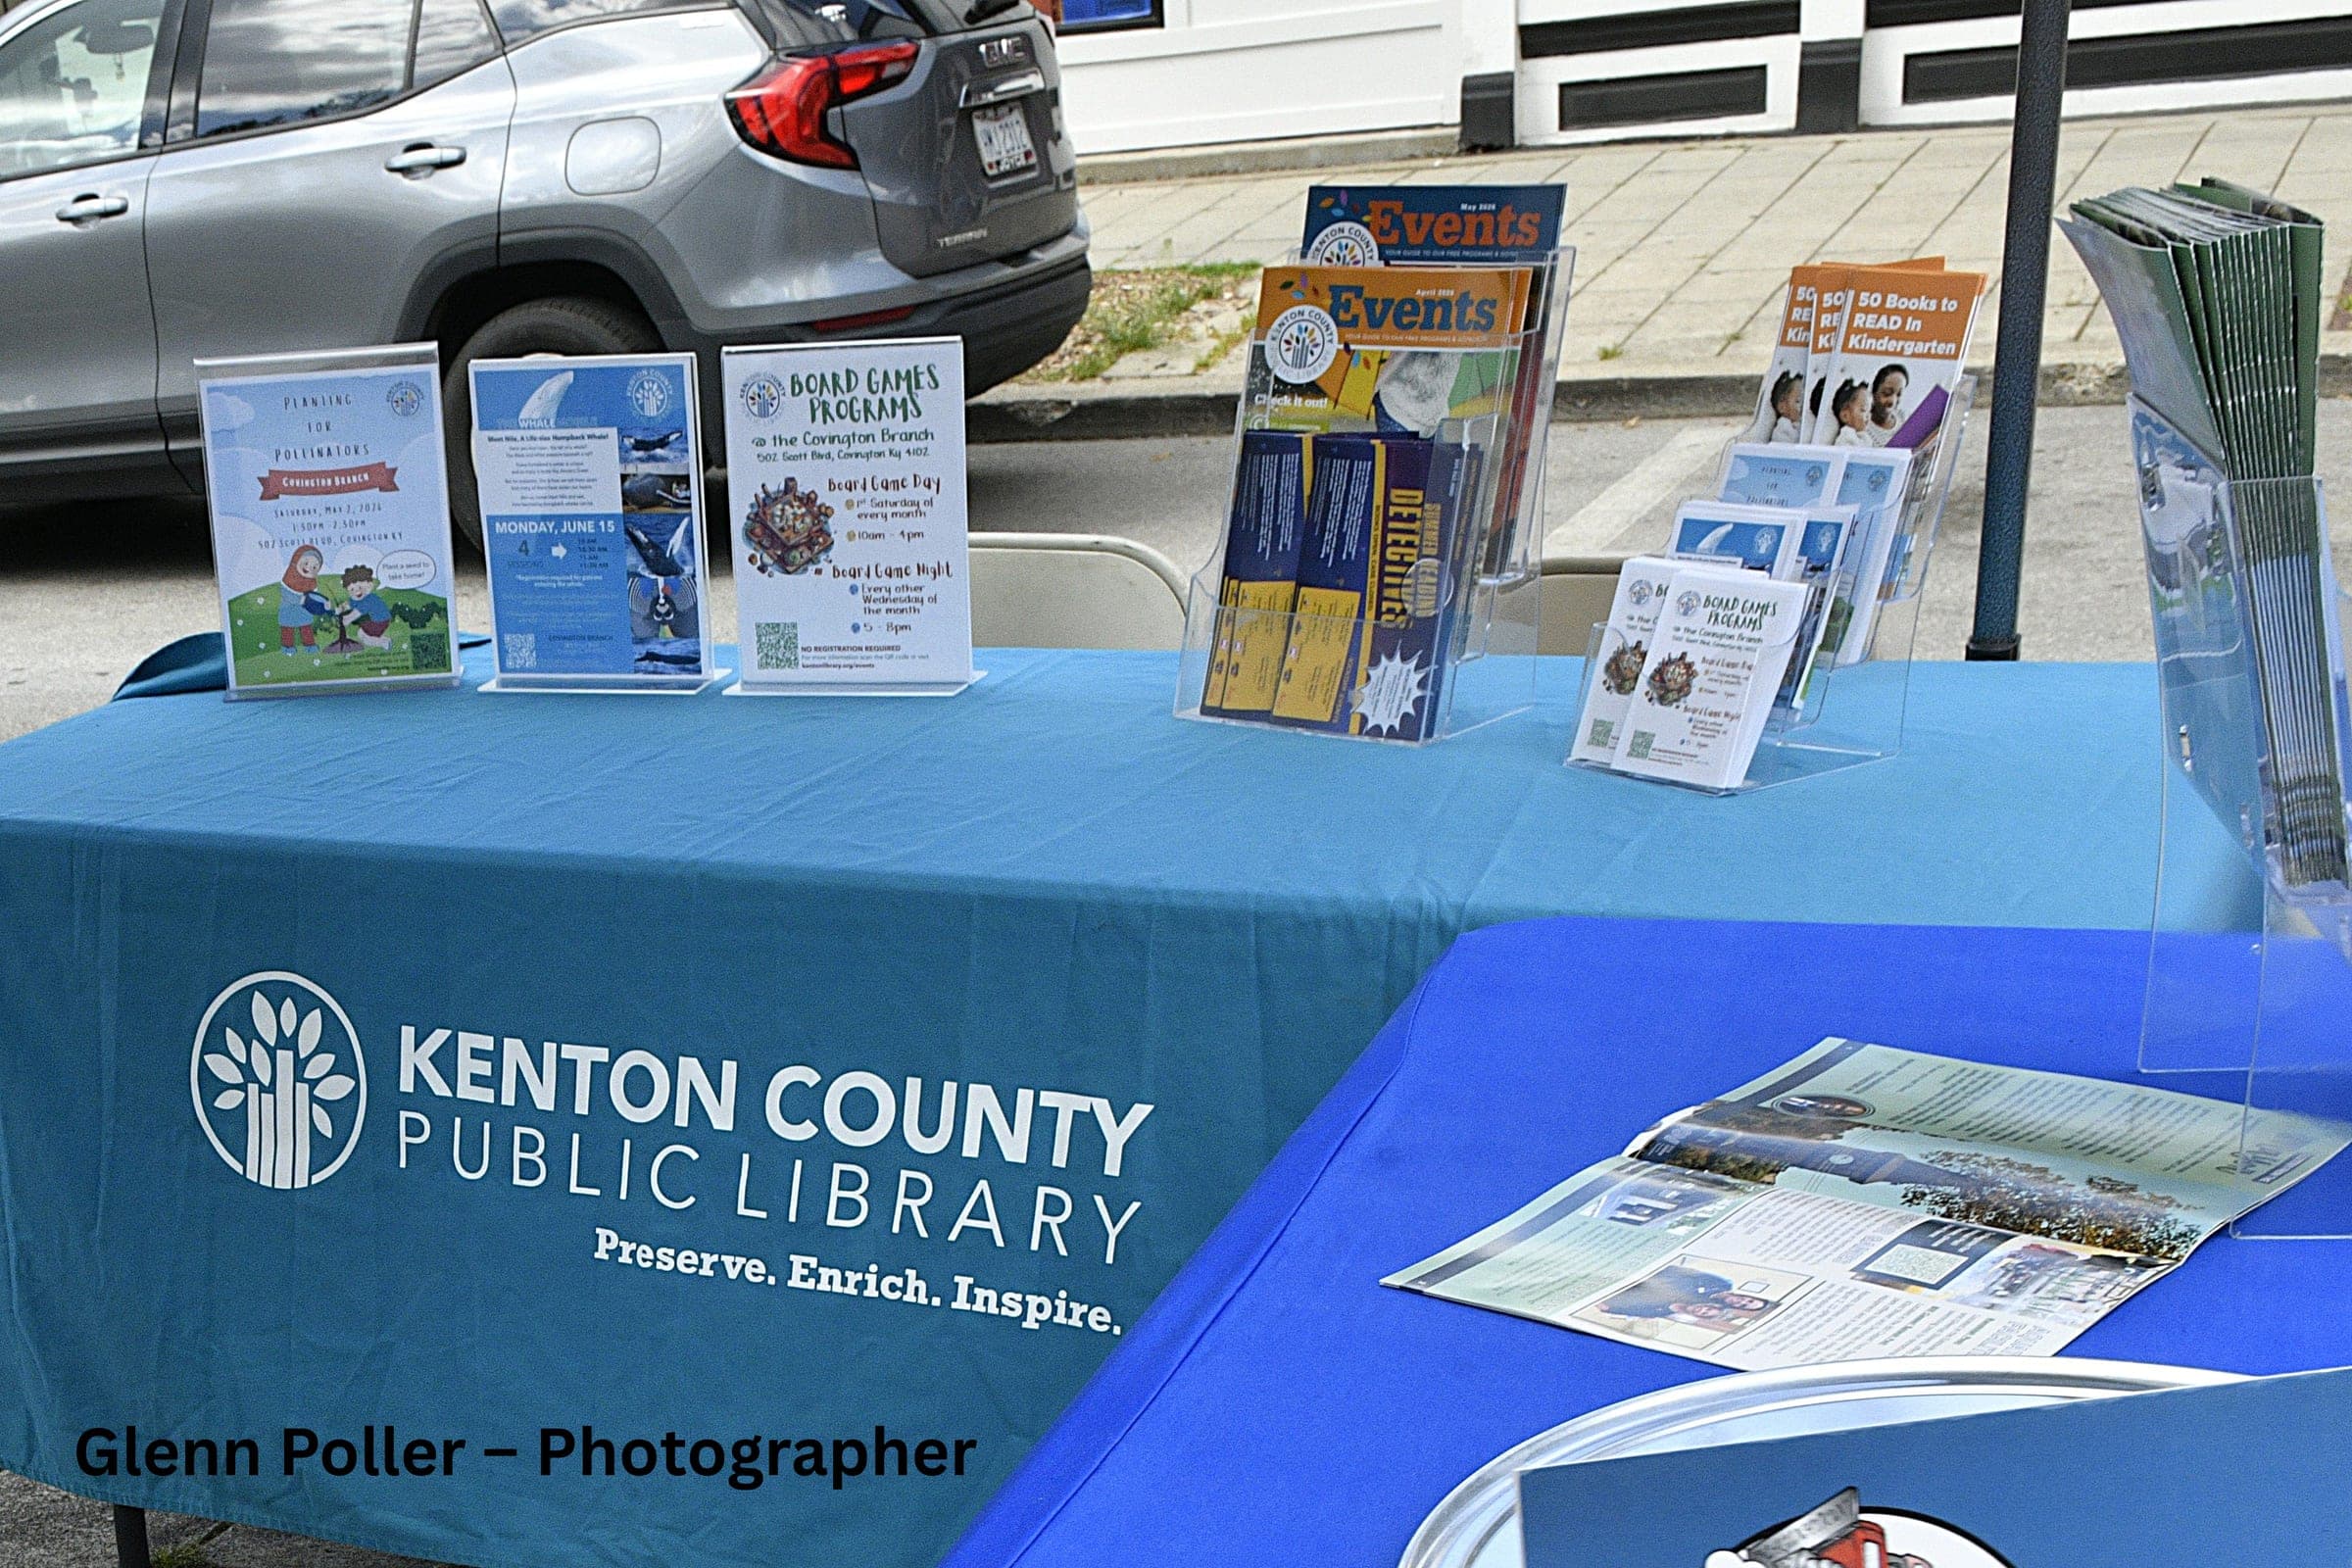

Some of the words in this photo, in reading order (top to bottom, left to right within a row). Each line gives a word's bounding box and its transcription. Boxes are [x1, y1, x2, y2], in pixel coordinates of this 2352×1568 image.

[1460, 203, 1477, 212] May
[1368, 200, 1542, 247] Events
[1329, 284, 1498, 332] Events
[1822, 292, 1844, 307] 50
[1858, 292, 1882, 307] 50
[1886, 293, 1936, 311] Books
[1940, 296, 1958, 312] to
[1308, 310, 1335, 344] COUNTY
[1853, 313, 1902, 330] READ
[1848, 333, 1956, 356] Kindergarten
[790, 368, 858, 397] BOARD
[867, 364, 940, 395] GAMES
[809, 392, 922, 424] PROGRAMS
[1294, 393, 1302, 407] it
[1304, 397, 1328, 409] out!
[519, 418, 556, 429] WHALE
[772, 434, 798, 447] the
[803, 430, 875, 450] Covington
[881, 427, 935, 442] Branch
[274, 444, 369, 462] POLLINATORS
[783, 451, 807, 462] Scott
[837, 448, 885, 463] Covington
[889, 448, 902, 461] Ky
[828, 476, 866, 492] Board
[871, 475, 908, 492] Game
[912, 473, 941, 495] Day
[870, 497, 920, 510] Saturday
[923, 497, 933, 508] of
[858, 512, 888, 521] every
[891, 510, 926, 519] month
[495, 521, 559, 535] MONDAY,
[561, 520, 595, 533] JUNE
[599, 520, 615, 533] 15
[858, 531, 885, 540] 10am
[900, 530, 924, 543] 4pm
[518, 540, 529, 557] 4
[833, 564, 870, 579] Board
[874, 563, 911, 580] Game
[916, 561, 953, 580] Night
[861, 583, 892, 596] Every
[895, 584, 925, 594] other
[862, 595, 924, 607] Wednesday
[927, 593, 938, 605] of
[1703, 595, 1740, 612] BOARD
[863, 607, 881, 615] the
[886, 606, 920, 615] month
[1707, 611, 1763, 632] PROGRAMS
[400, 1025, 738, 1132] KENTON
[765, 1064, 1154, 1177] COUNTY
[399, 1110, 700, 1209] PUBLIC
[737, 1152, 1142, 1265] LIBRARY
[594, 1227, 776, 1286] Preserve.
[787, 1253, 941, 1307] Enrich.
[951, 1276, 1122, 1337] Inspire.
